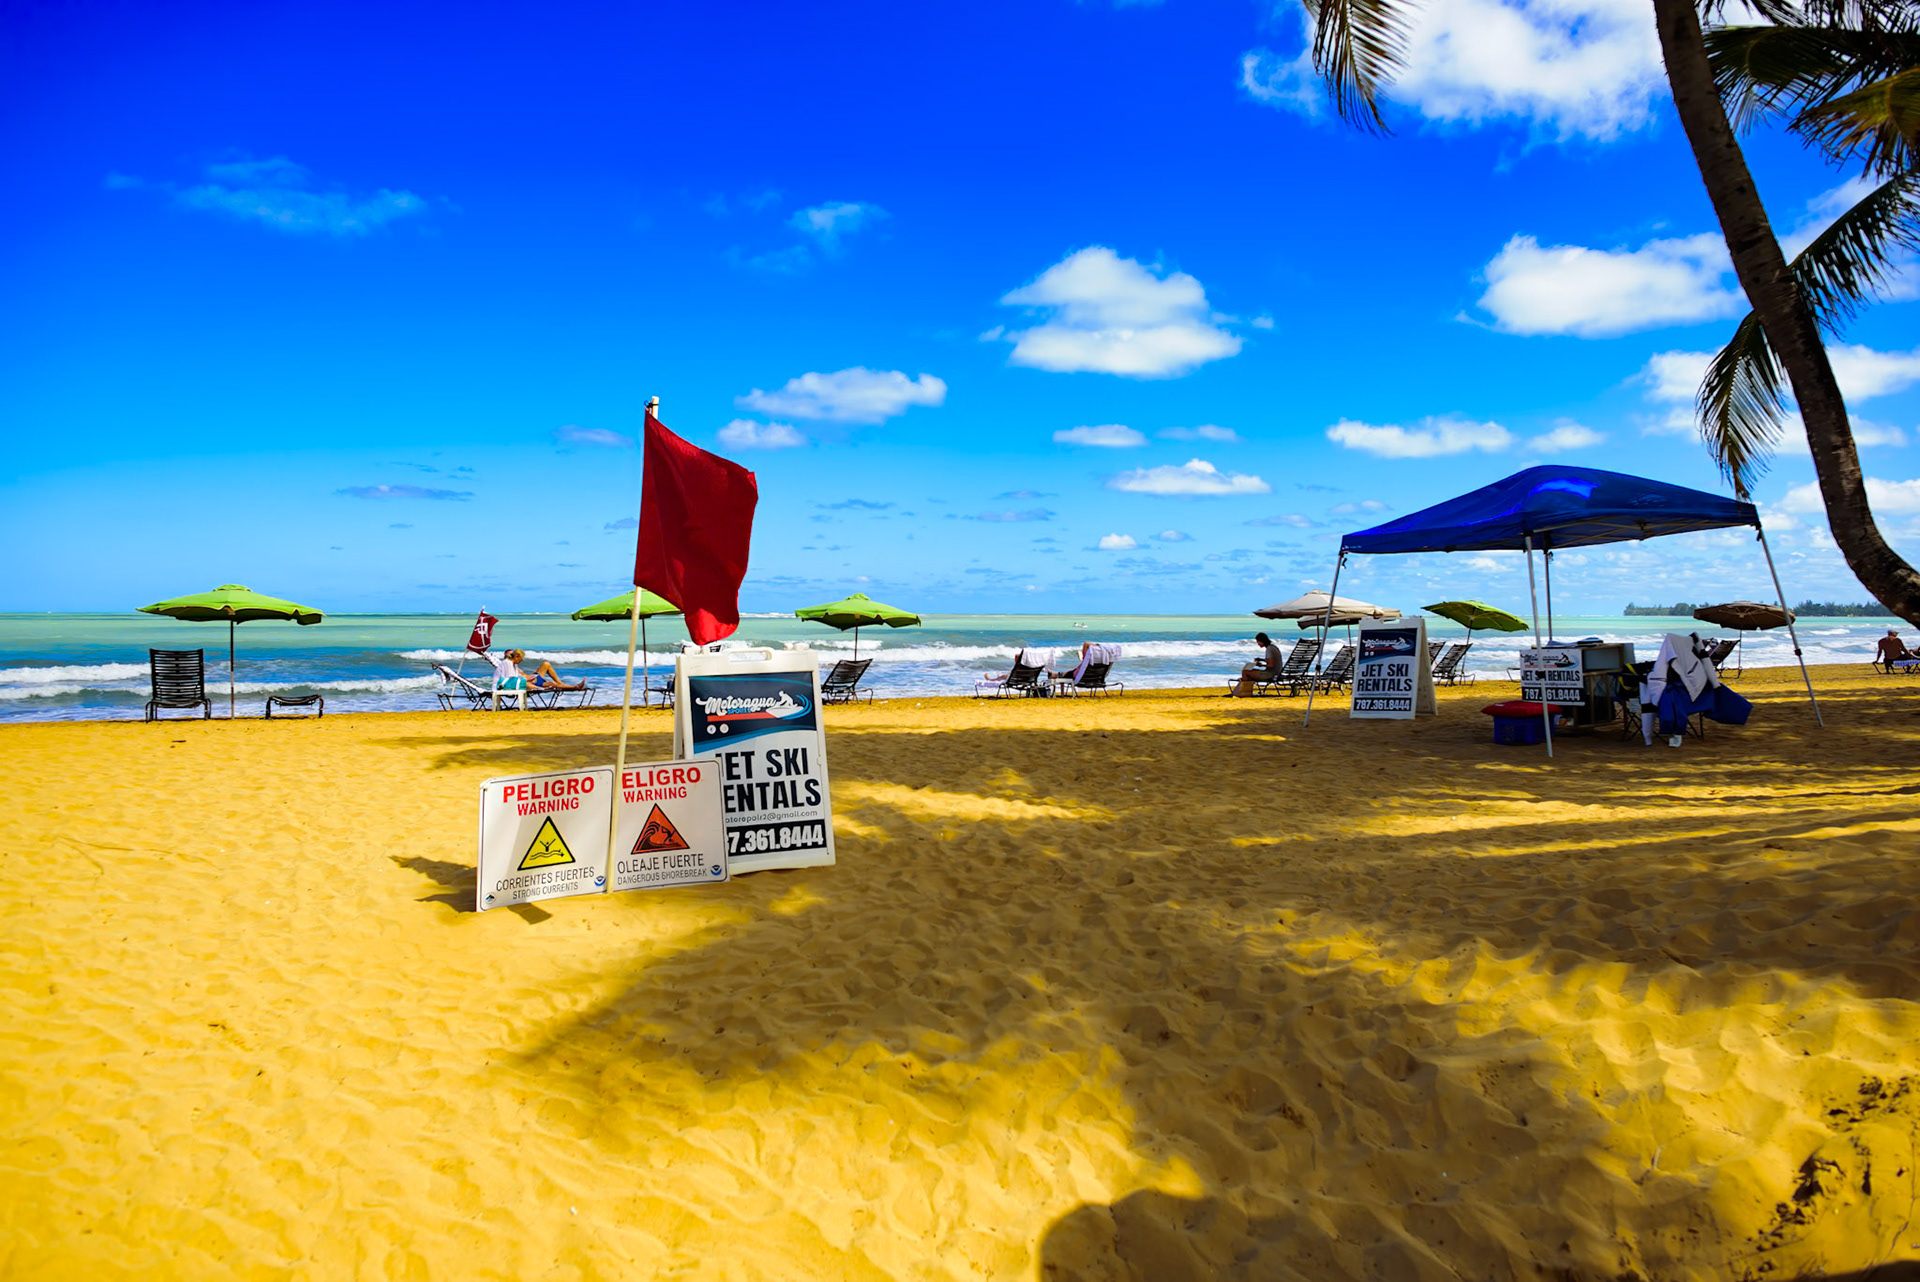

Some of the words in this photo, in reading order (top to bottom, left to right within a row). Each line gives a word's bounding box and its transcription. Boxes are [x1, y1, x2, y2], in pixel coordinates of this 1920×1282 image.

[1362, 664, 1383, 677] JET
[1387, 664, 1409, 677] SKI
[1548, 670, 1580, 681] RENTALS
[1357, 679, 1412, 691] RENTALS
[1524, 688, 1580, 700] 787.61.8444
[695, 695, 777, 716] Motoragua
[1356, 699, 1409, 710] 787.361.8444
[766, 748, 809, 777] SKI
[622, 767, 701, 789] ELIGRO
[503, 776, 595, 803] PELIGRO
[623, 786, 688, 803] WARNING
[723, 779, 821, 813] ENTALS
[517, 797, 579, 816] WARNING
[728, 824, 824, 854] 7.361.8444
[617, 857, 660, 874] OLEAJE
[663, 853, 704, 869] FUERTE
[496, 872, 553, 892] CORRIENTES
[555, 866, 595, 883] FUERTES
[617, 871, 660, 885] DANGEROUS
[661, 868, 707, 880] SHOREBREAK
[512, 887, 541, 900] STRONG
[542, 881, 579, 895] CURRENTS
